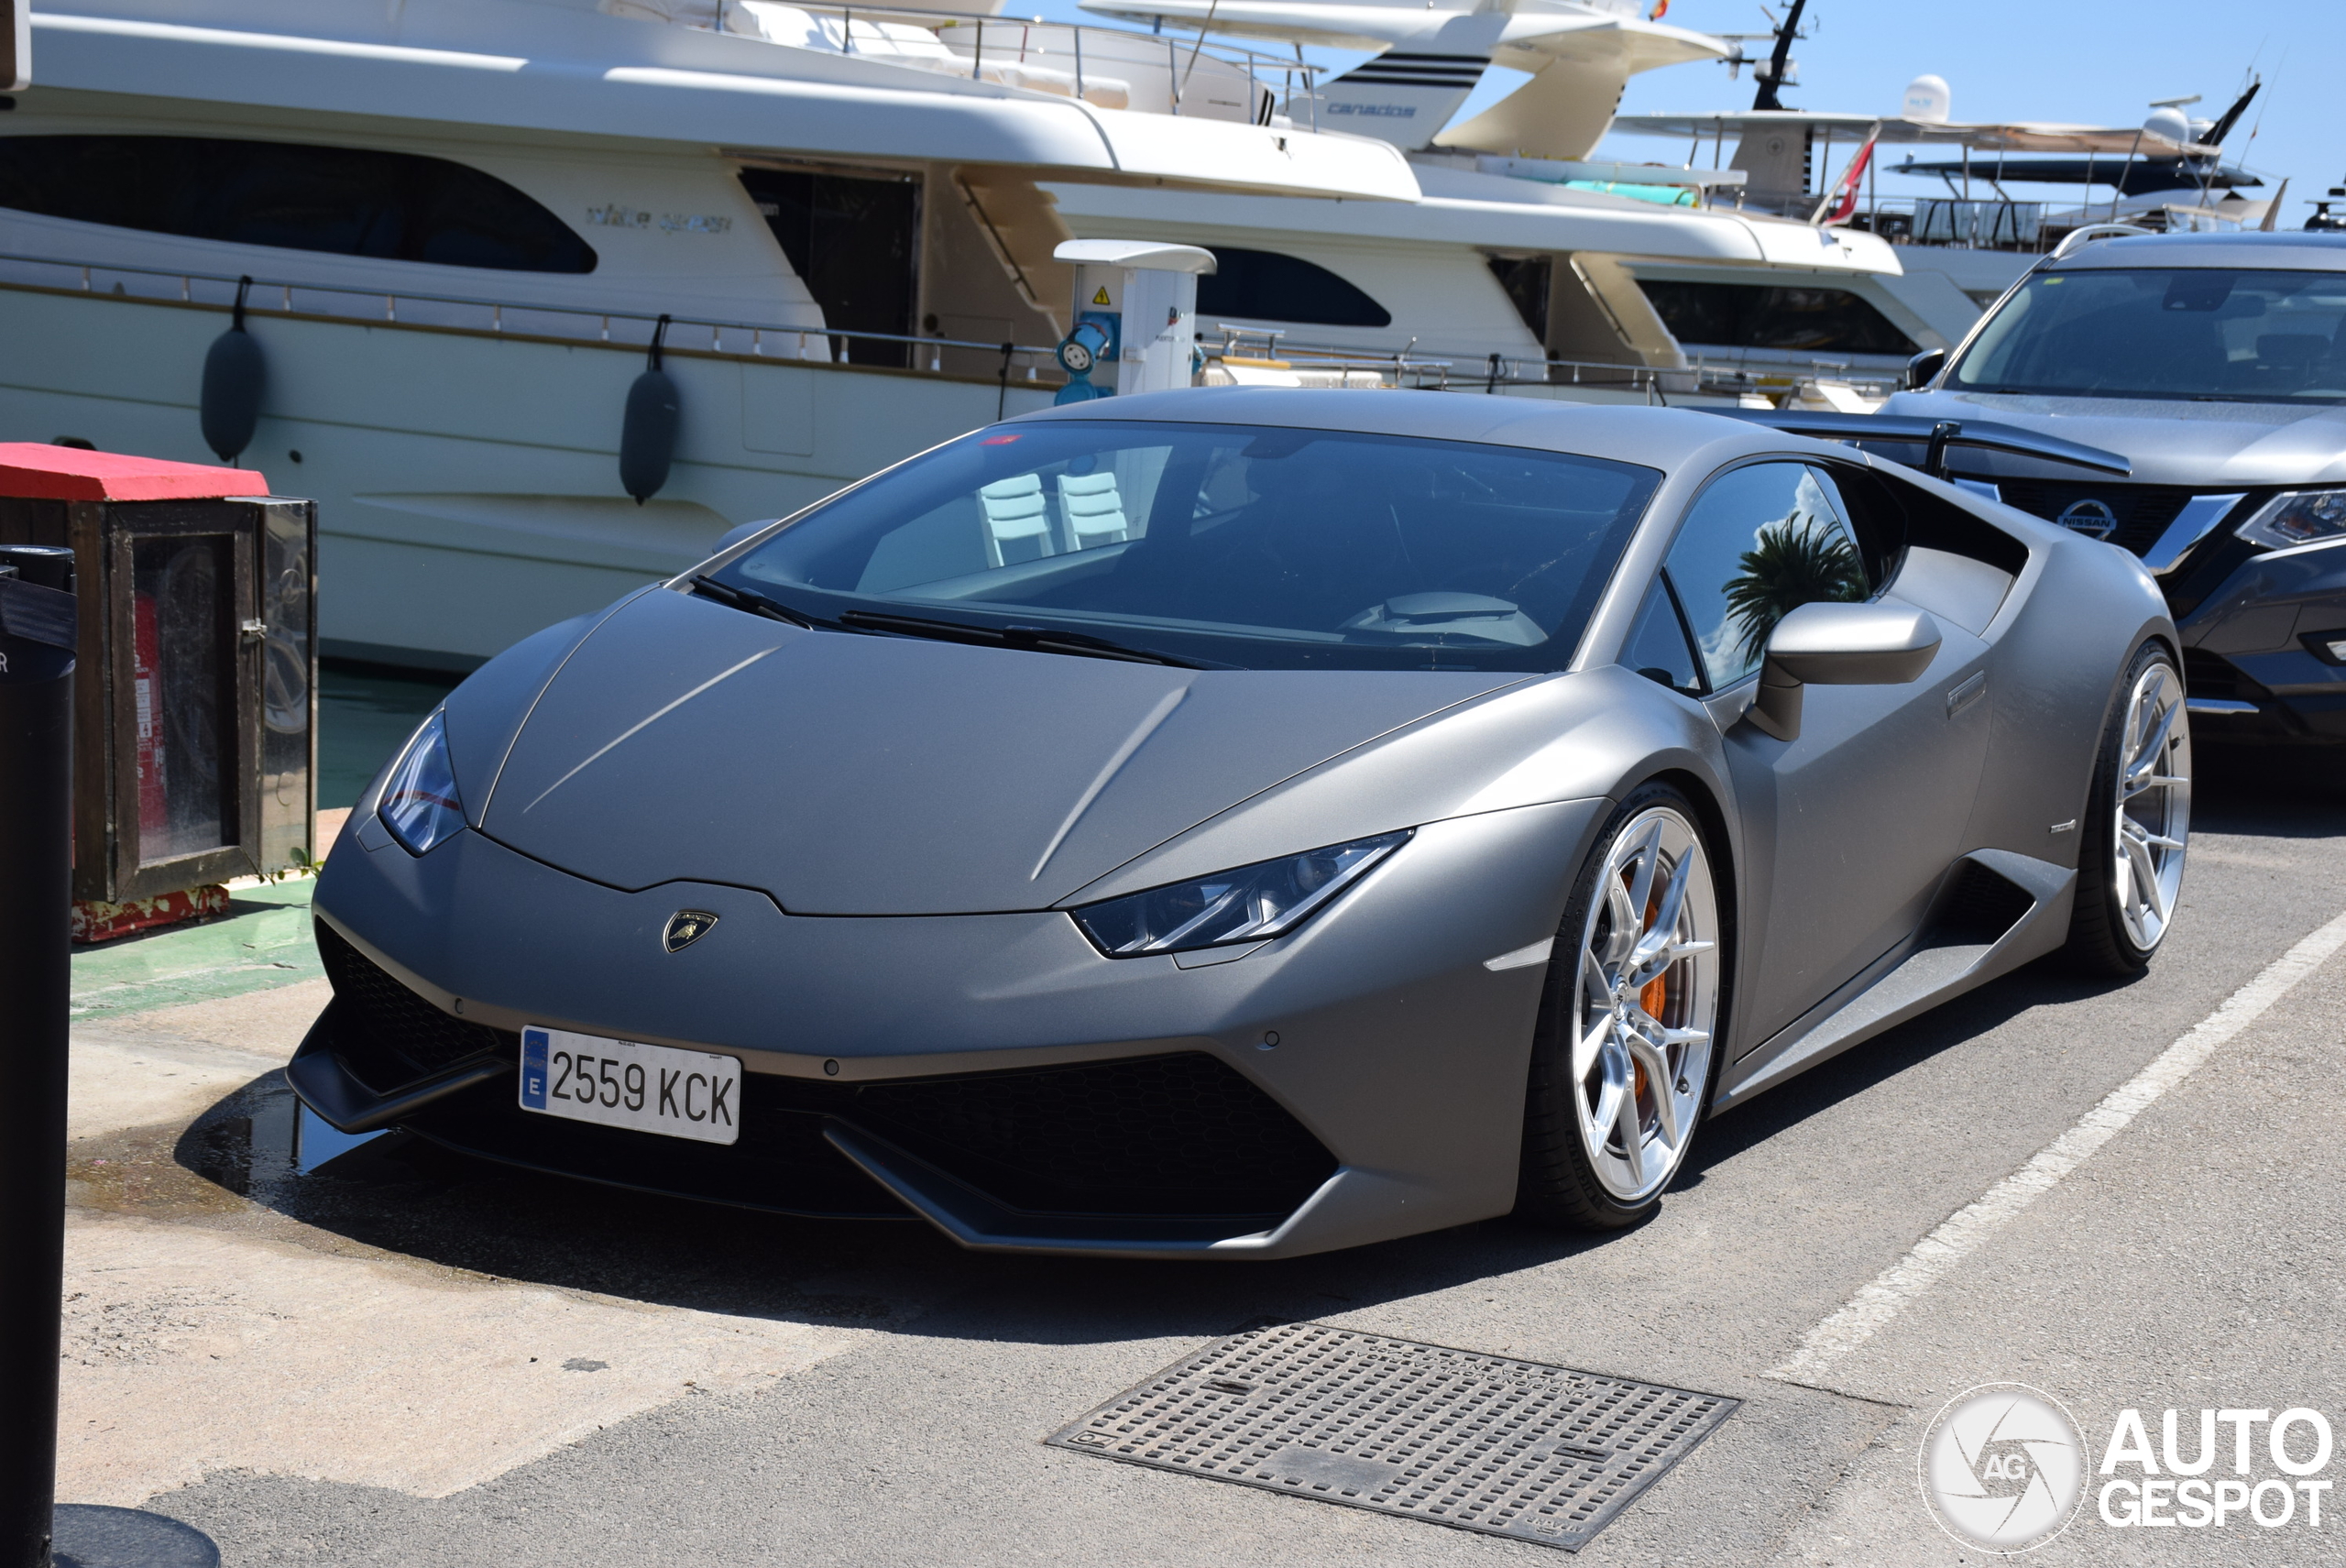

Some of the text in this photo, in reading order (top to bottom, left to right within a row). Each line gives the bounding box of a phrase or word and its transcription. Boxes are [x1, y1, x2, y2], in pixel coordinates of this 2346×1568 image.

[2063, 518, 2110, 528] NISSAN
[529, 1078, 541, 1095] E
[552, 1051, 733, 1126] 2559 KCK
[1437, 1366, 1500, 1381] DUCTIL
[1500, 1377, 1597, 1398] FUNDICION
